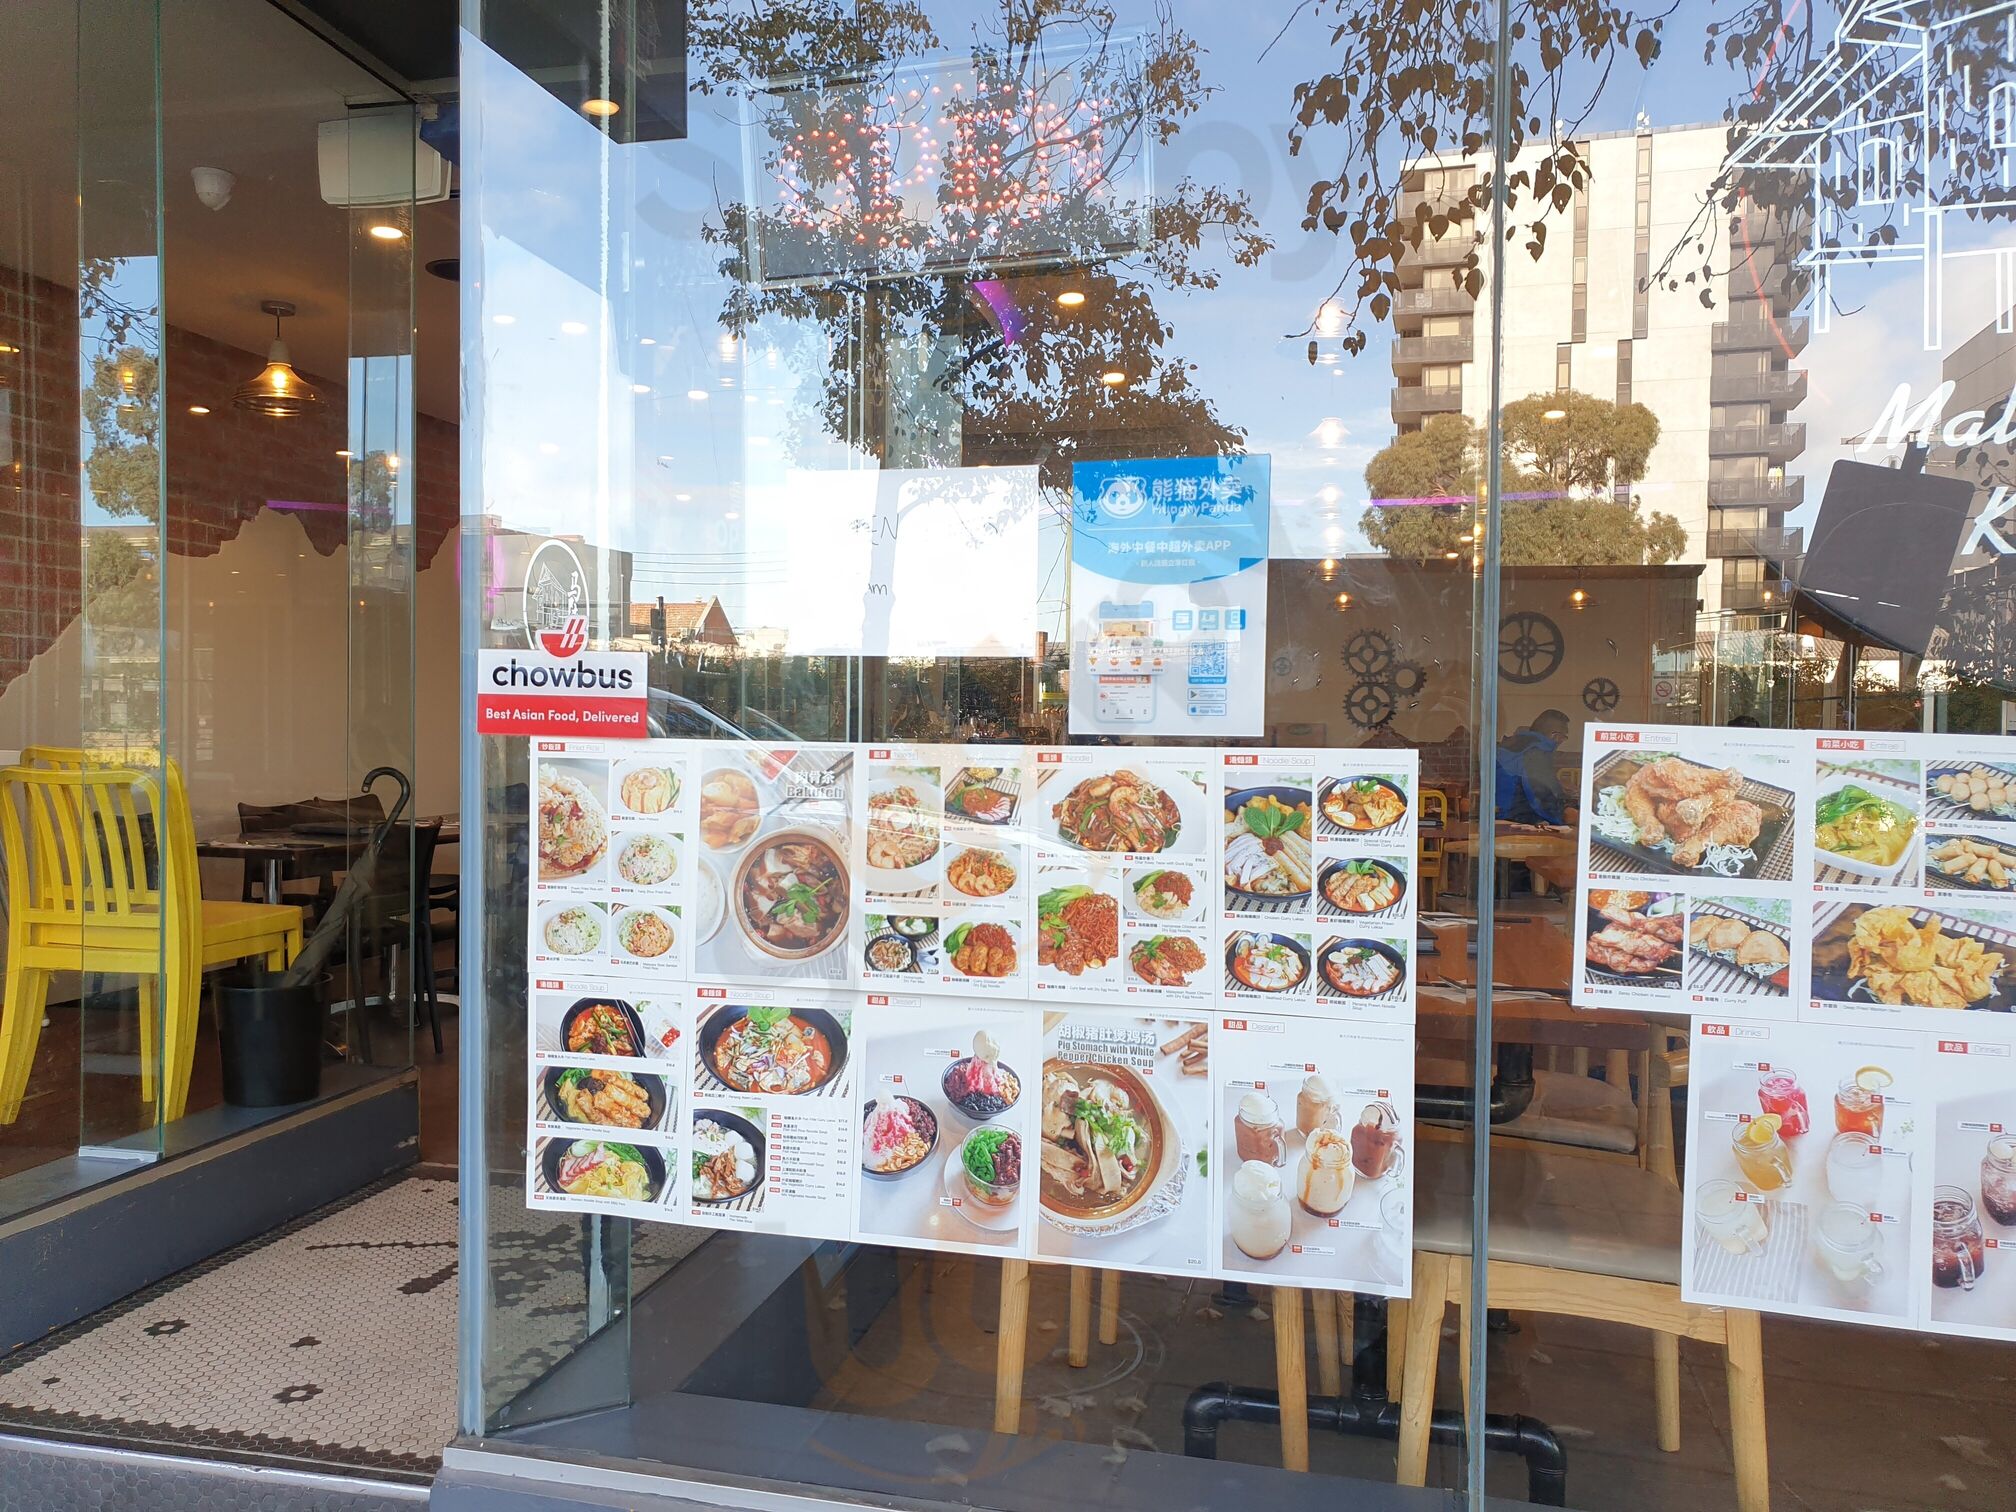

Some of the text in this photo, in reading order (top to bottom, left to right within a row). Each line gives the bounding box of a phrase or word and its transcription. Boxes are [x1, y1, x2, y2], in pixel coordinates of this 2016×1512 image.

[1152, 476, 1243, 502] 熊猫外卖
[492, 658, 633, 690] chowbus
[486, 708, 639, 724] Best Asian Food, Delivered
[1263, 757, 1311, 766] Noodle Soup
[567, 983, 605, 992] Noodle Soup
[730, 990, 771, 999] Noodle Soup
[1252, 1023, 1279, 1031] Dessert
[1057, 1024, 1157, 1047] 胡椒猪肚煲鸡汤
[1057, 1040, 1155, 1057] Pig Stomach with White
[1091, 1053, 1129, 1065] Chicken
[1131, 1057, 1154, 1068] Soup
